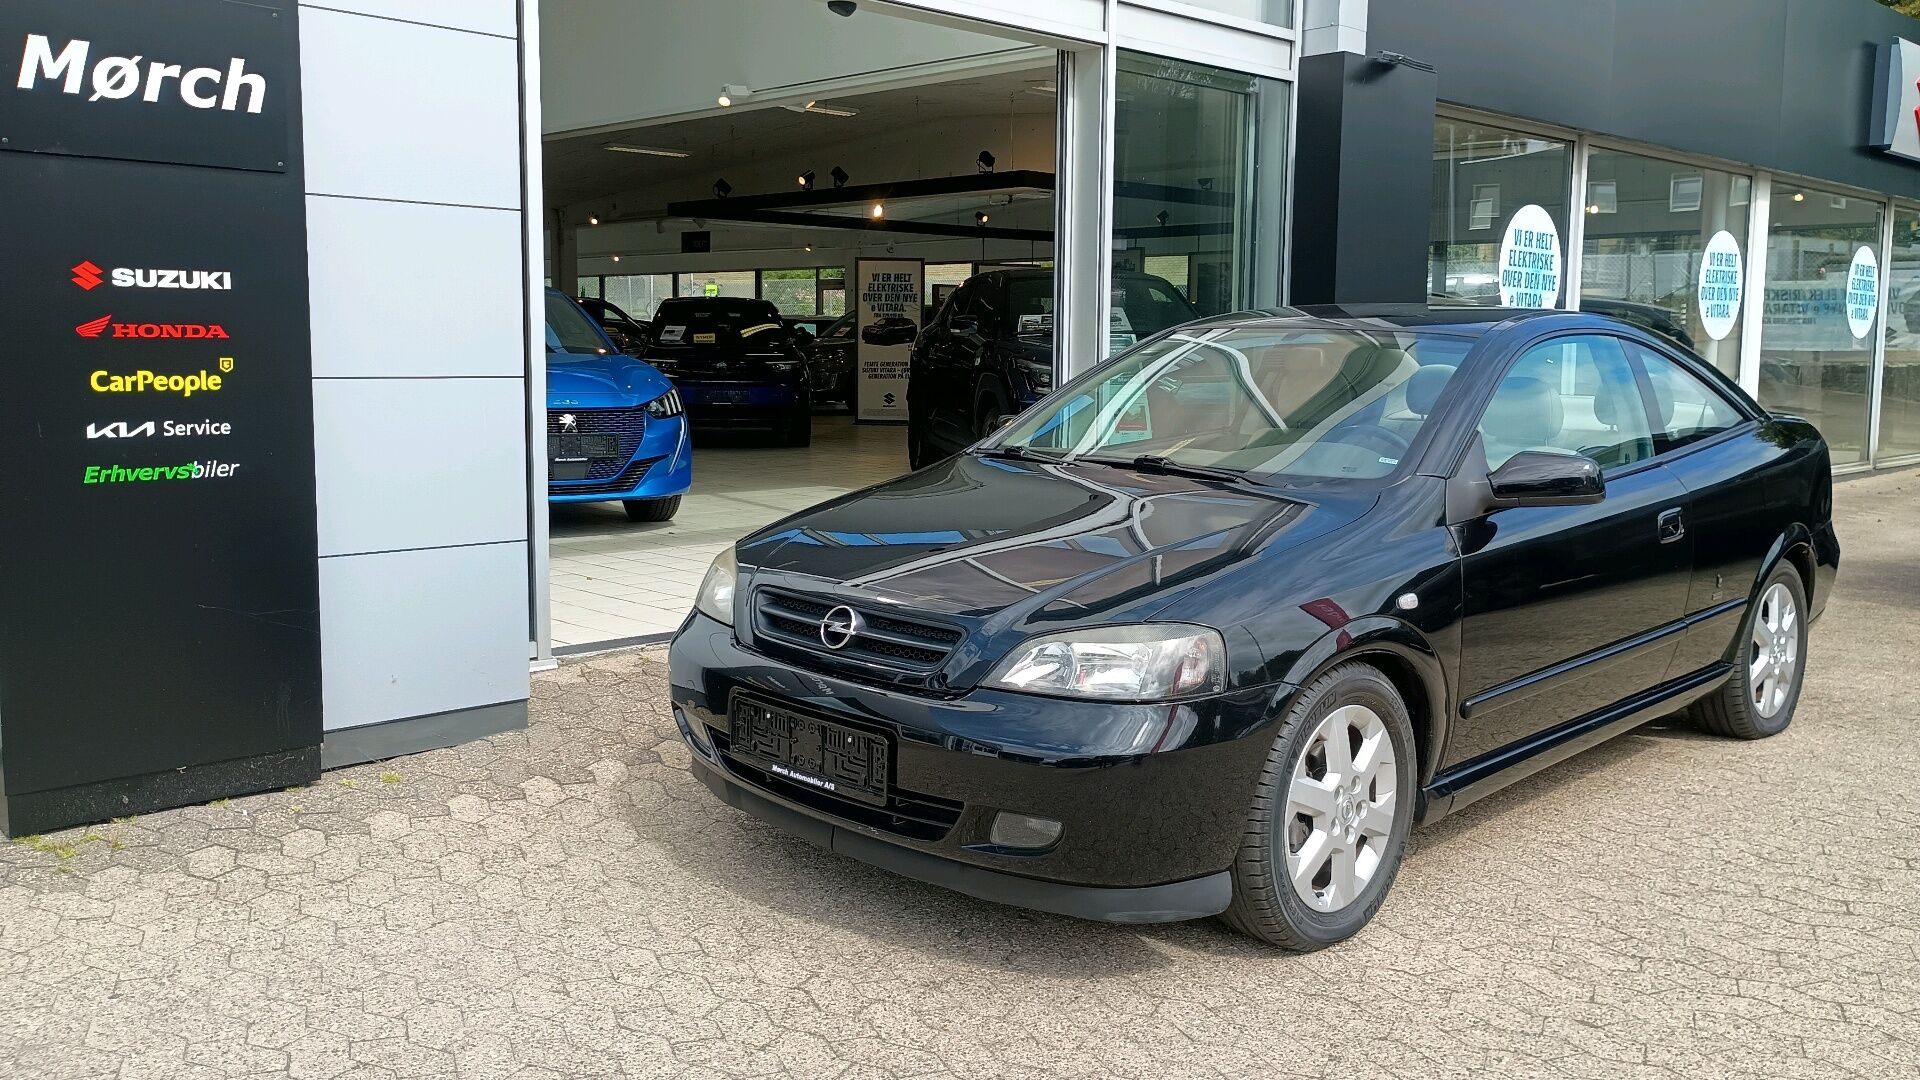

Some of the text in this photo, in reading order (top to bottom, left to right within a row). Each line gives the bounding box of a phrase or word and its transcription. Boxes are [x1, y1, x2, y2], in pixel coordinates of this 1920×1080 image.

[17, 33, 267, 114] Mørch
[1514, 229, 1554, 250] VI ER HELT
[1509, 249, 1554, 271] ELEKTRISKE
[1716, 252, 1724, 267] ER
[1725, 253, 1737, 267] HELT
[112, 268, 232, 290] SUZUKI
[872, 273, 912, 282] VI ER HELT
[1502, 269, 1556, 291] OVER DEN NYE
[1705, 269, 1737, 284] ELEKTRISKE
[863, 293, 917, 302] OVER DEN NYE
[868, 283, 914, 292] ELEKTRISKE
[1701, 286, 1715, 301] OVER
[112, 323, 230, 339] HONDA
[90, 370, 222, 397] CarPeople
[86, 419, 232, 439] KIA Service
[83, 460, 240, 484] Erhvervsbiler
